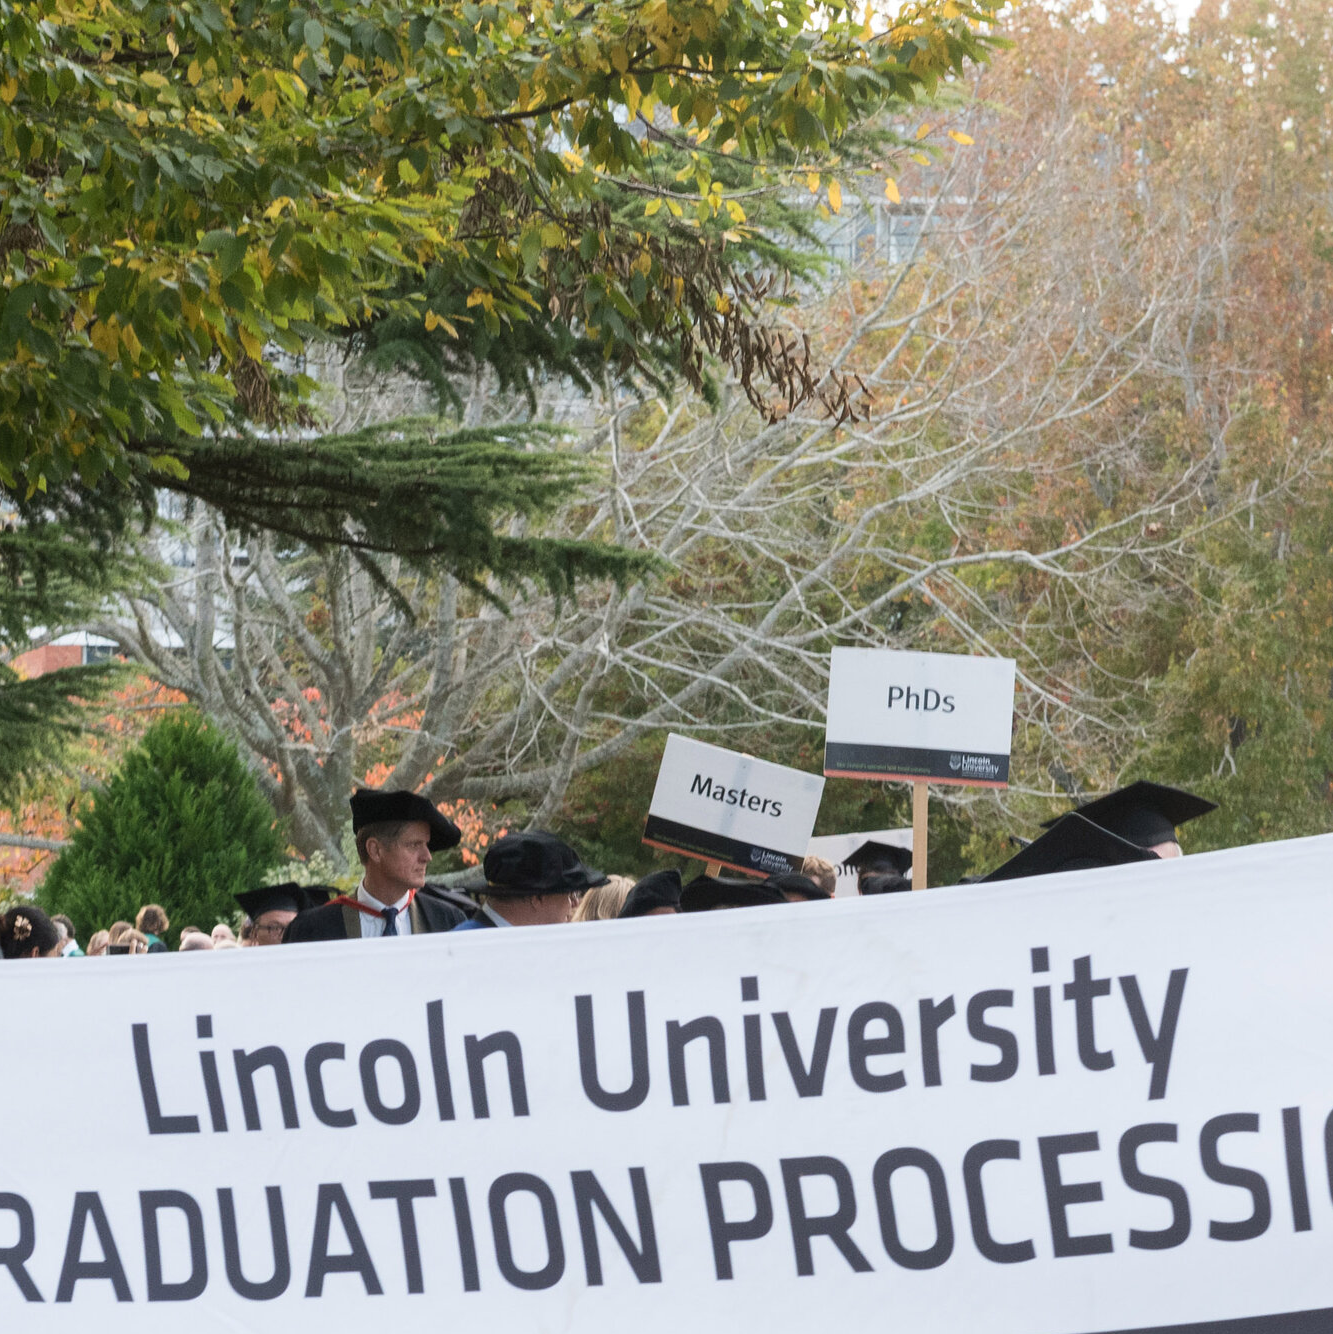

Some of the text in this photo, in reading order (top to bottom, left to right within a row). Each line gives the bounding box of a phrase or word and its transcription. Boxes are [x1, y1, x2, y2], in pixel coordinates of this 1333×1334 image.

[887, 686, 956, 713] PhDs
[962, 754, 991, 766] Lincoln
[690, 773, 784, 818] Masters
[132, 947, 1189, 1135] Lincoln University
